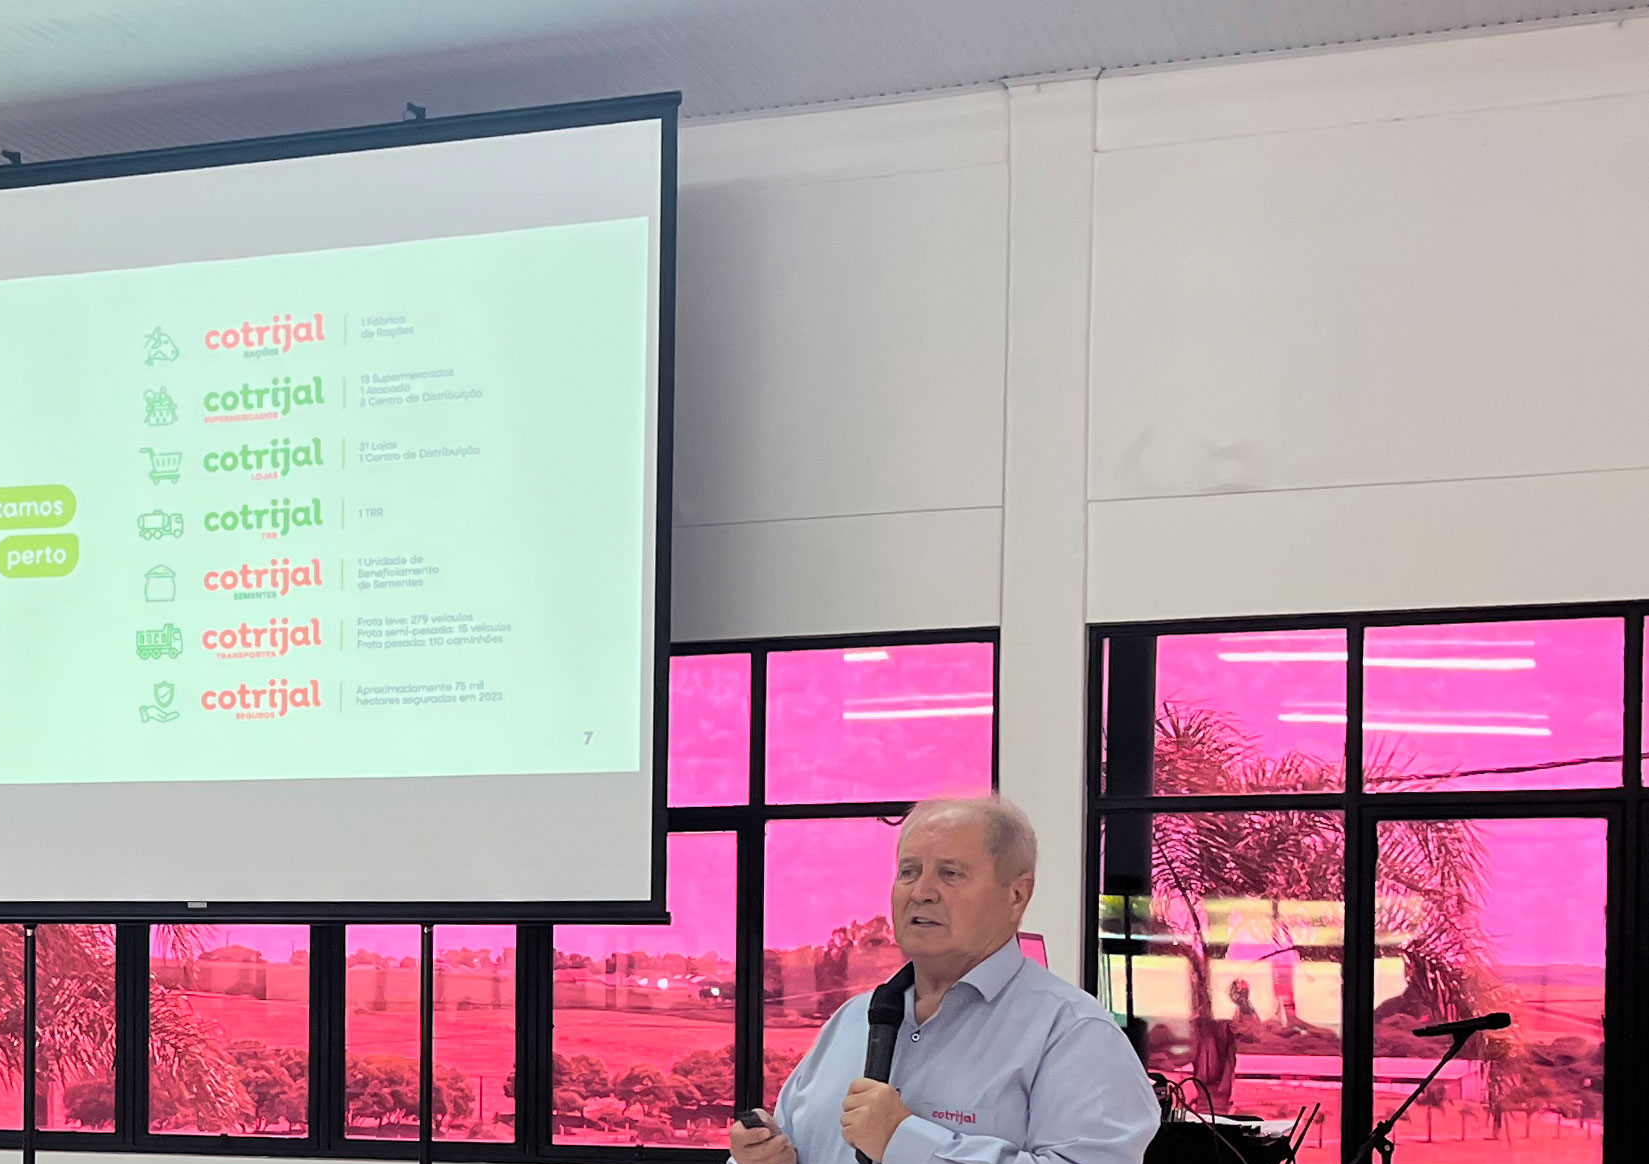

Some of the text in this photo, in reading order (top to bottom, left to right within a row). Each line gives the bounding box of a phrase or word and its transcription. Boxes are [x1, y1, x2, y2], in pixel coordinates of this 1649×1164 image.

[367, 315, 407, 327] Fábrica
[204, 313, 325, 353] cotrijal
[360, 326, 416, 339] de Rações
[372, 368, 455, 384] Supermercados
[204, 376, 325, 416] cotrijal
[368, 396, 404, 407] Centro
[405, 393, 420, 403] de
[422, 388, 483, 402] Distribuição
[366, 451, 401, 462] Centro
[403, 450, 417, 460] de
[419, 445, 481, 459] Distribuição
[371, 440, 398, 453] Lojas
[203, 437, 324, 477] cotrijal
[251, 471, 278, 481] LOJAS
[203, 498, 323, 536] cotrijal
[364, 507, 384, 518] TRR
[7, 545, 67, 571] perto
[364, 556, 407, 567] Unidade
[409, 555, 424, 565] de
[203, 558, 322, 596] cotrijal
[358, 565, 440, 579] Beneficiamento
[357, 578, 424, 590] de Sementes
[357, 616, 383, 627] Frota
[410, 614, 429, 625] 279
[431, 612, 473, 624] veículos
[202, 617, 322, 656] cotrijal
[357, 622, 512, 638] Frota semi-pesada: 15 veículos
[357, 633, 504, 651] Frota pesada: 110 caminhões
[216, 651, 276, 660] TRANSPORTES
[356, 683, 452, 696] Aproximadamente
[469, 680, 485, 690] mil
[201, 678, 322, 717] cotrijal
[356, 694, 400, 706] hectares
[459, 693, 476, 702] em
[478, 691, 503, 702] 2023
[236, 711, 275, 720] SEGUROS
[583, 731, 594, 745] 7
[932, 1110, 977, 1126] cotrijal
